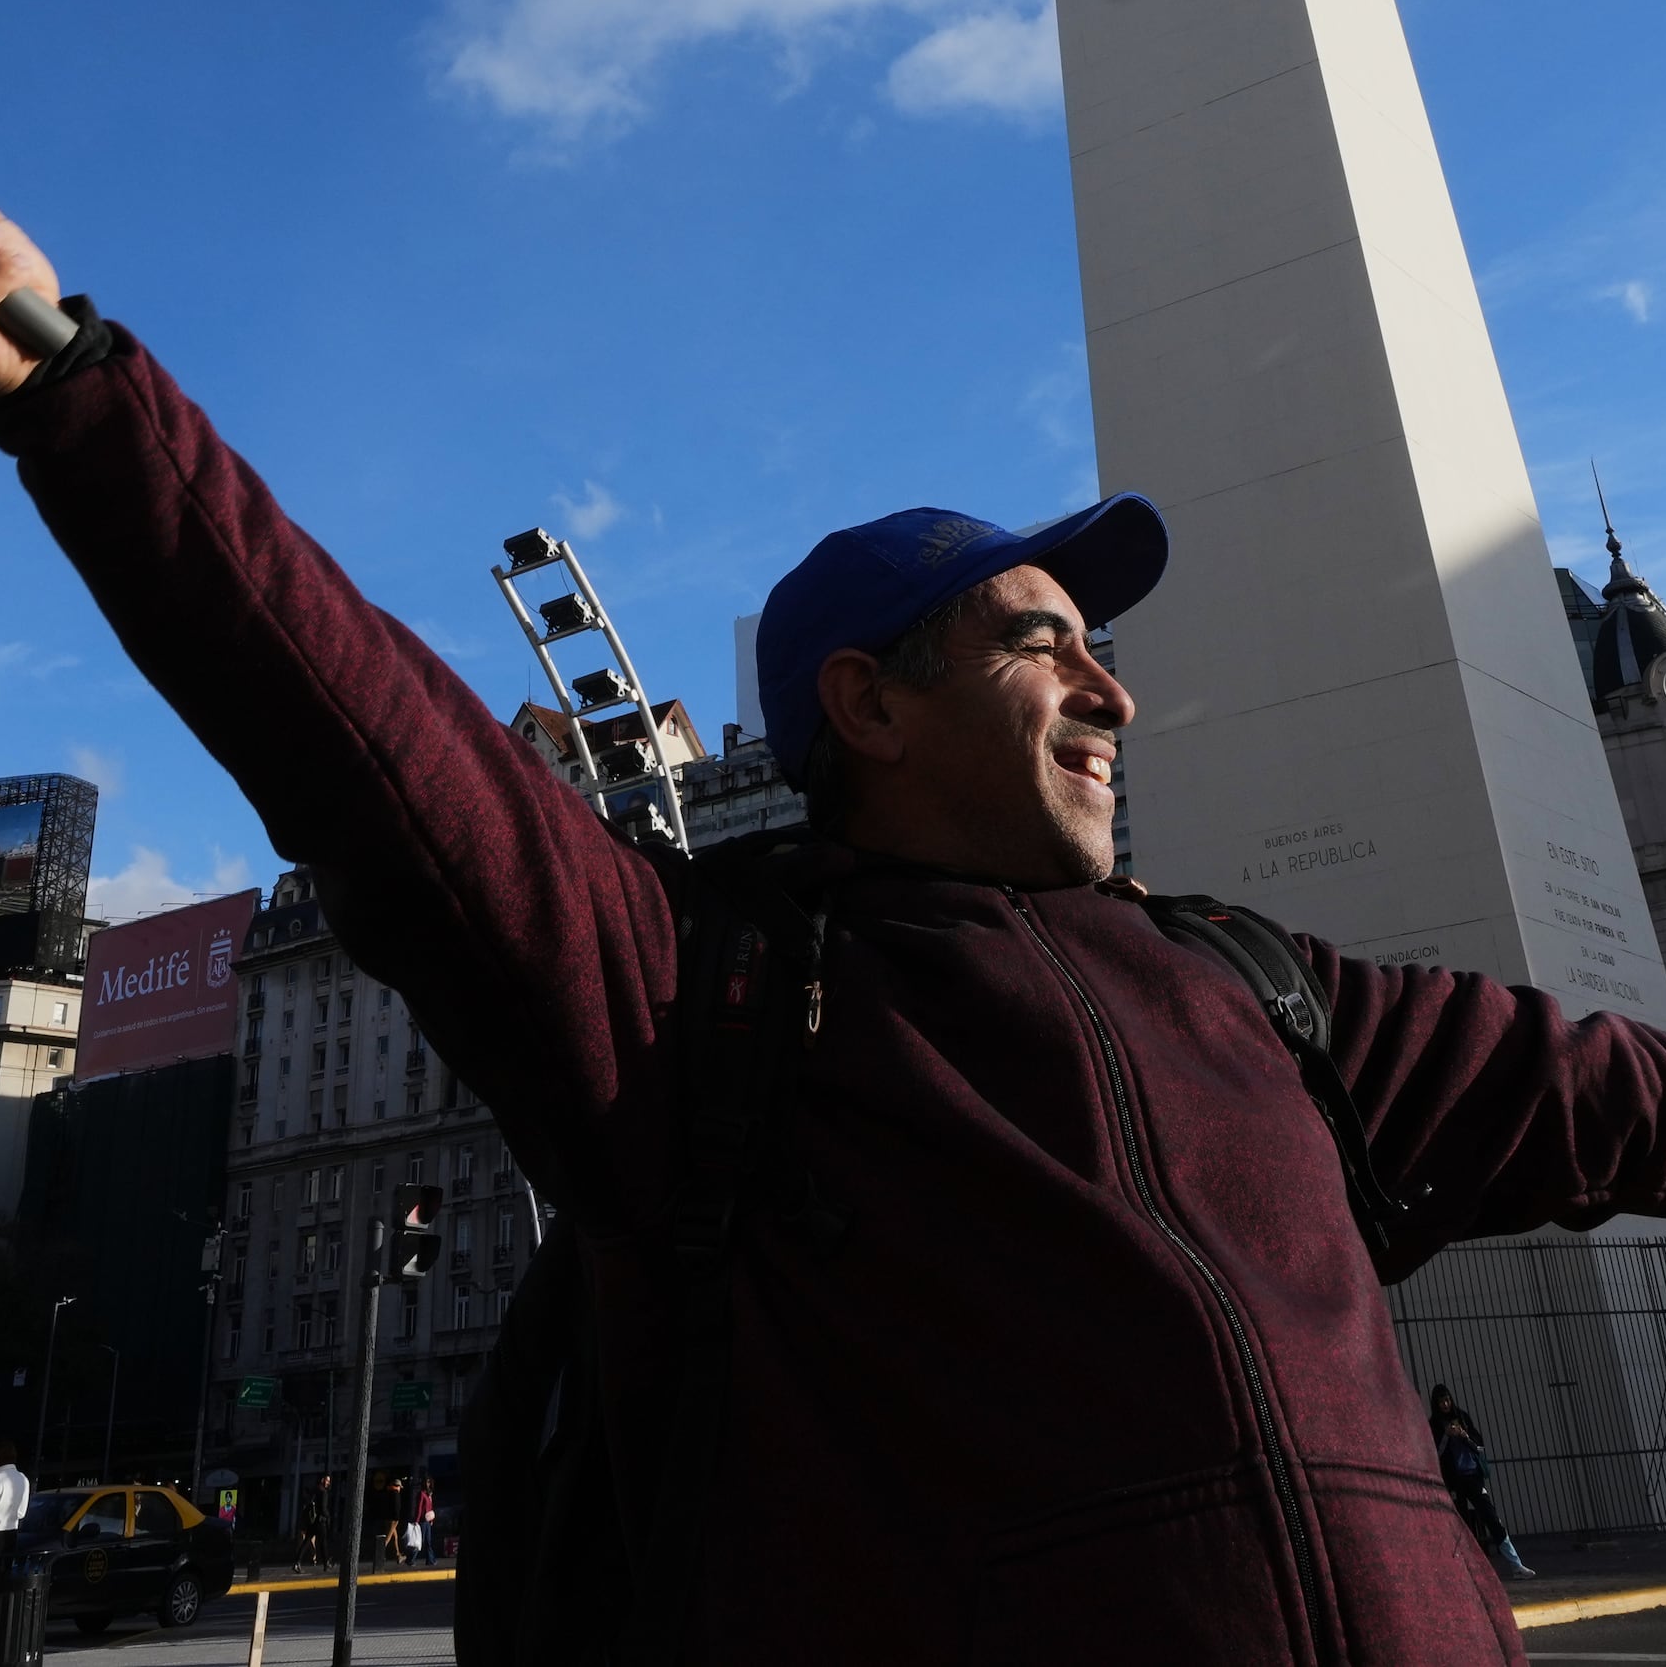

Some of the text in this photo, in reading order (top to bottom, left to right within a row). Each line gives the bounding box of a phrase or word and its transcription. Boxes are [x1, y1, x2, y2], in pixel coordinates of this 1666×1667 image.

[1264, 823, 1343, 849] BUENOS AIRES
[1243, 839, 1377, 883] A LA REPUBLICA
[1546, 841, 1600, 876] EN ESTE SITIO
[1376, 945, 1440, 967] FUNDACION
[96, 950, 190, 1006] Medifé
